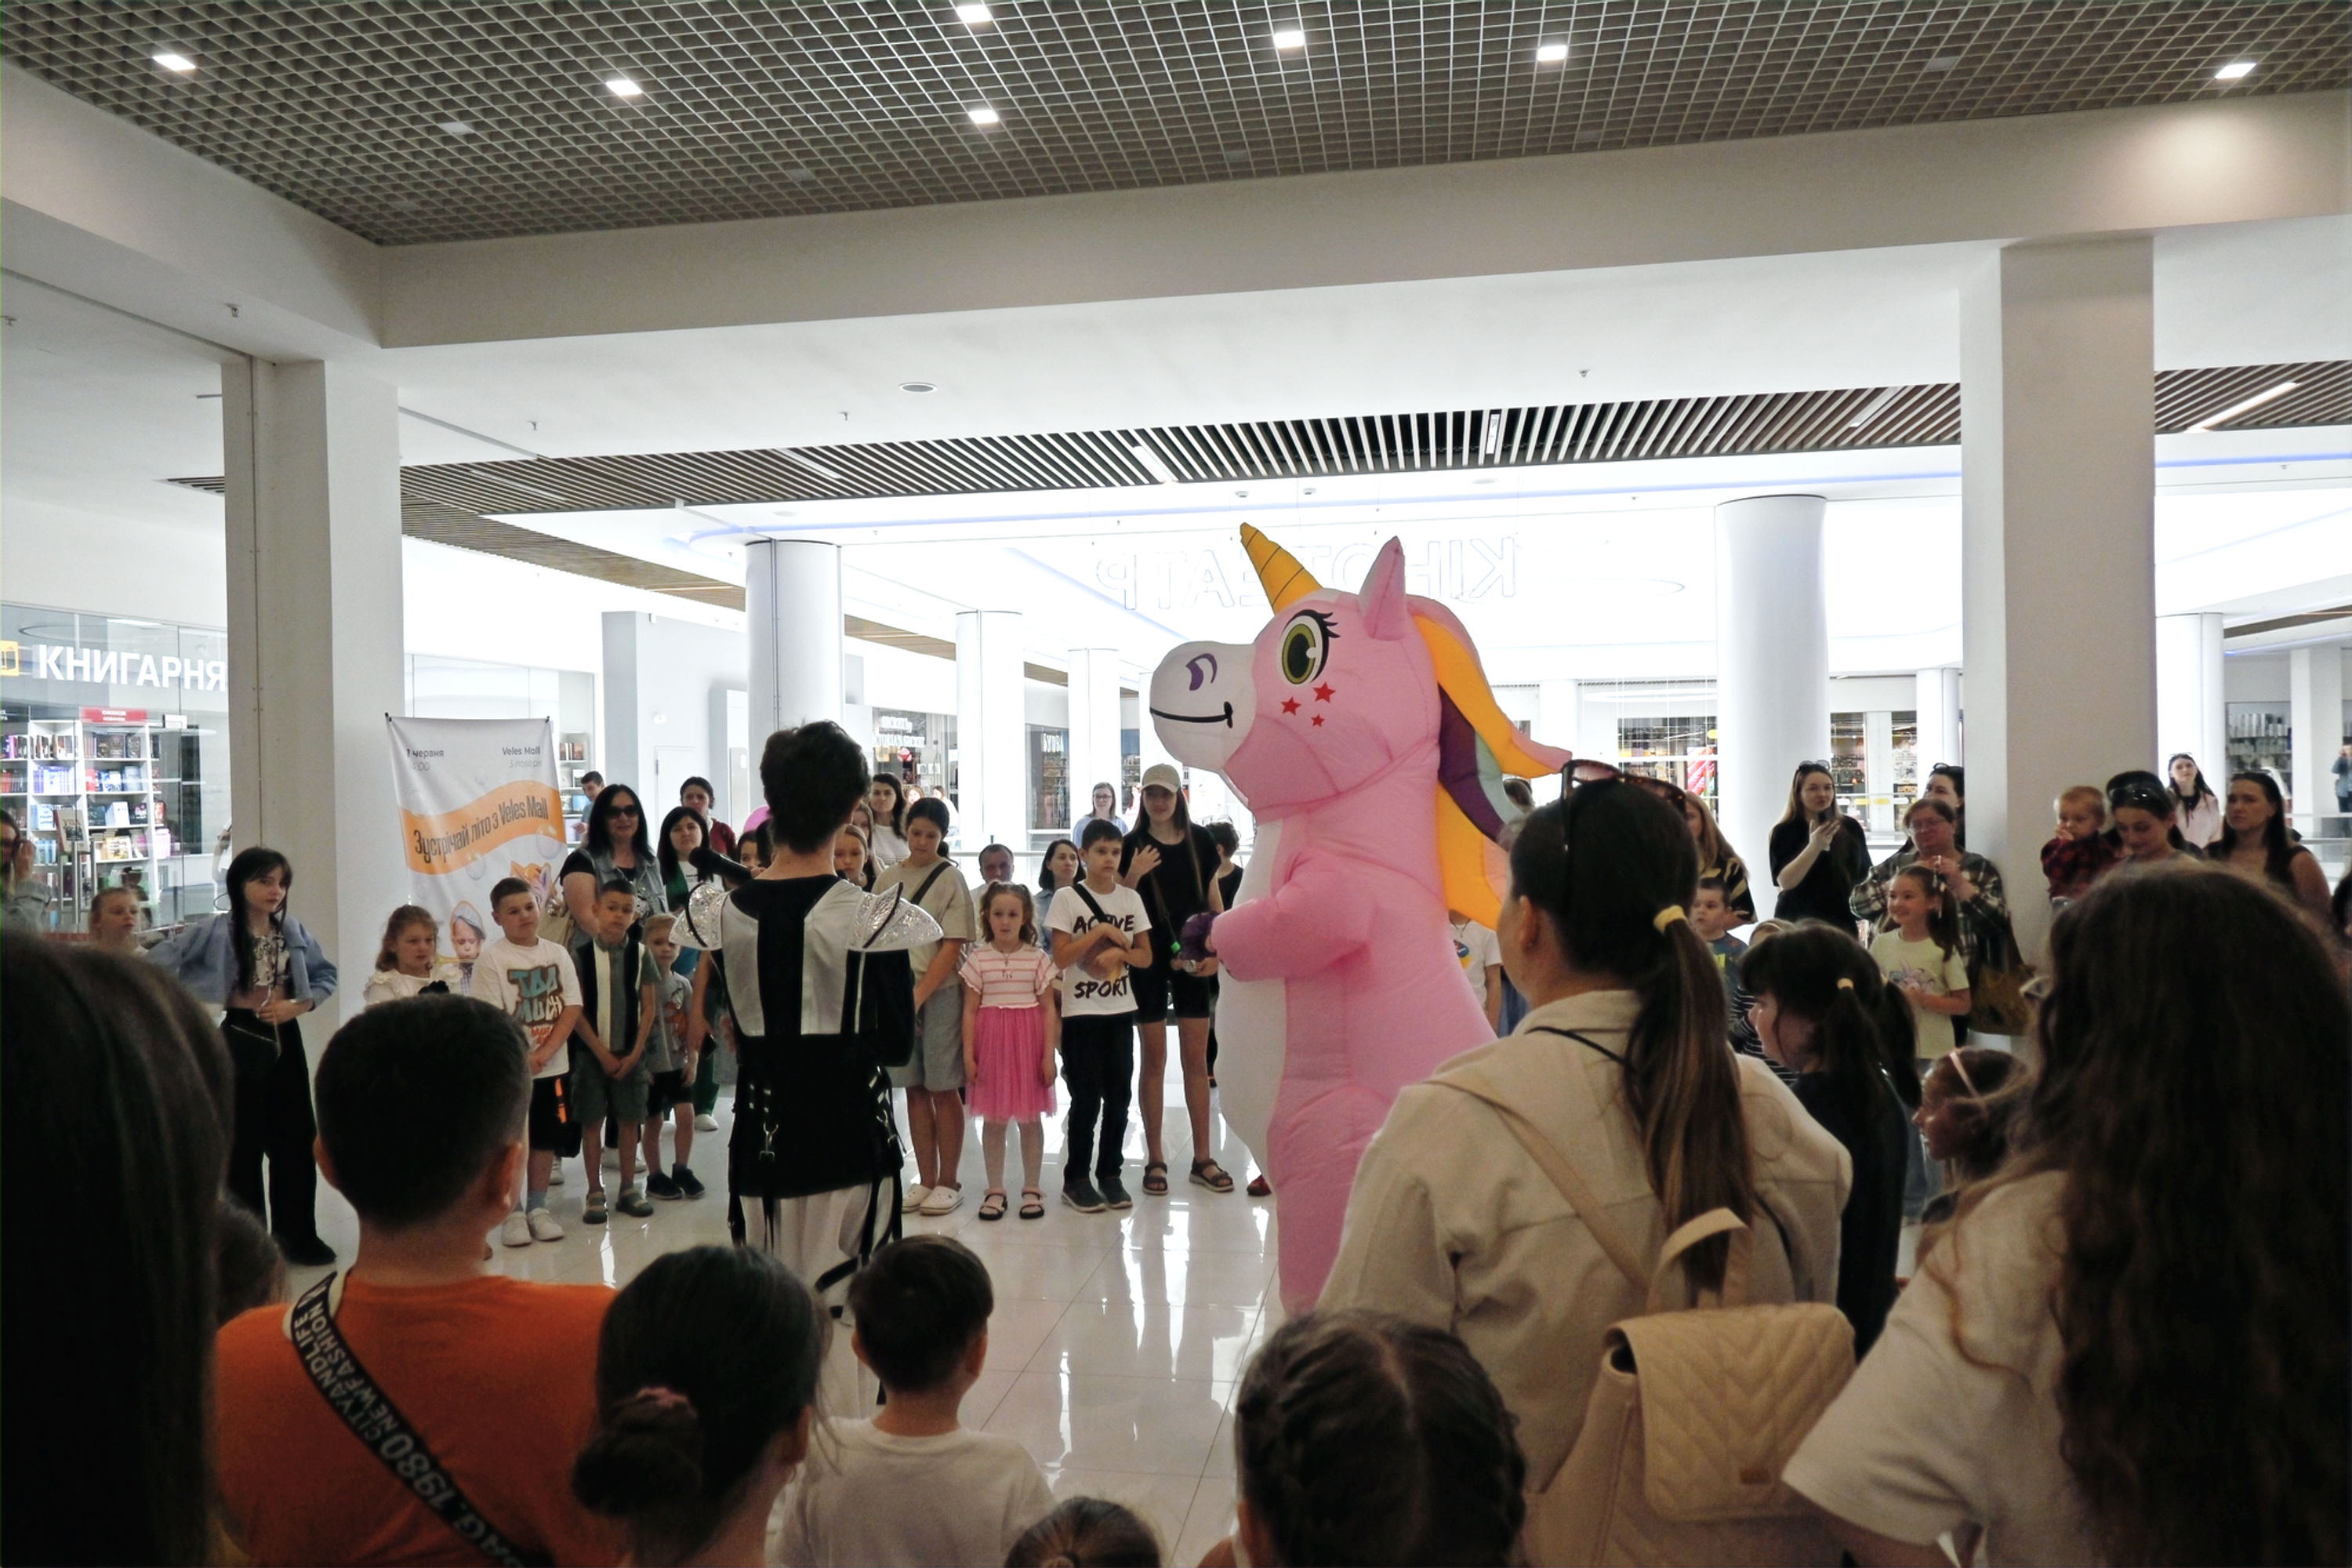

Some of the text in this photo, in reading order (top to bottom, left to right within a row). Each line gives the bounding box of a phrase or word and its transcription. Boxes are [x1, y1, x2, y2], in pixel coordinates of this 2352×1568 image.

[38, 644, 227, 692] КНИГАРНЯ
[412, 749, 445, 759] червня
[502, 746, 541, 756] Veles Mall
[413, 826, 470, 863] Зустрічай
[471, 816, 492, 843] літо
[499, 801, 527, 826] Veles
[526, 795, 549, 821] Mall
[1073, 914, 1135, 934] ACIVE
[1073, 975, 1129, 999] SPORT
[380, 1433, 456, 1509] 1980
